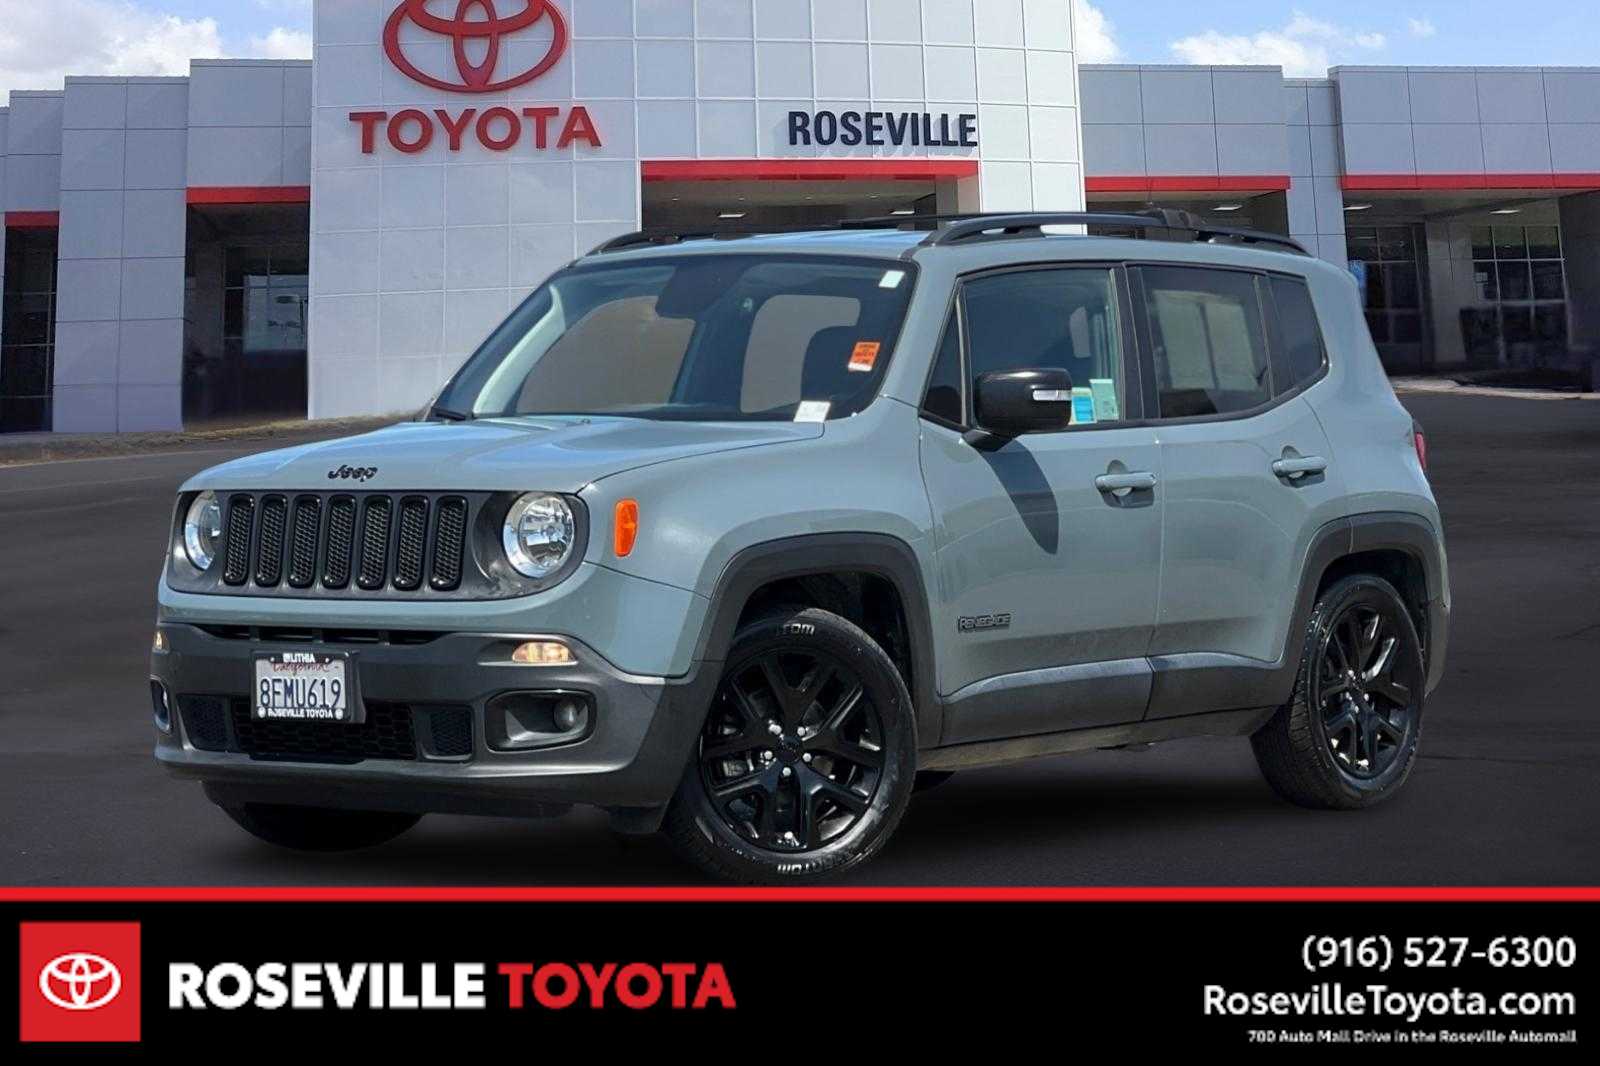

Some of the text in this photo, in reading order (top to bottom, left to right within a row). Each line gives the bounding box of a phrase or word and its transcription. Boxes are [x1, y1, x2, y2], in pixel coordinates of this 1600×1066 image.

[349, 106, 602, 154] TOYOTA
[788, 111, 978, 147] ROSEVILLE
[328, 465, 378, 482] Jeep
[260, 678, 341, 708] 8FMU619
[268, 708, 334, 719] ROSEVILLE TOYOTA
